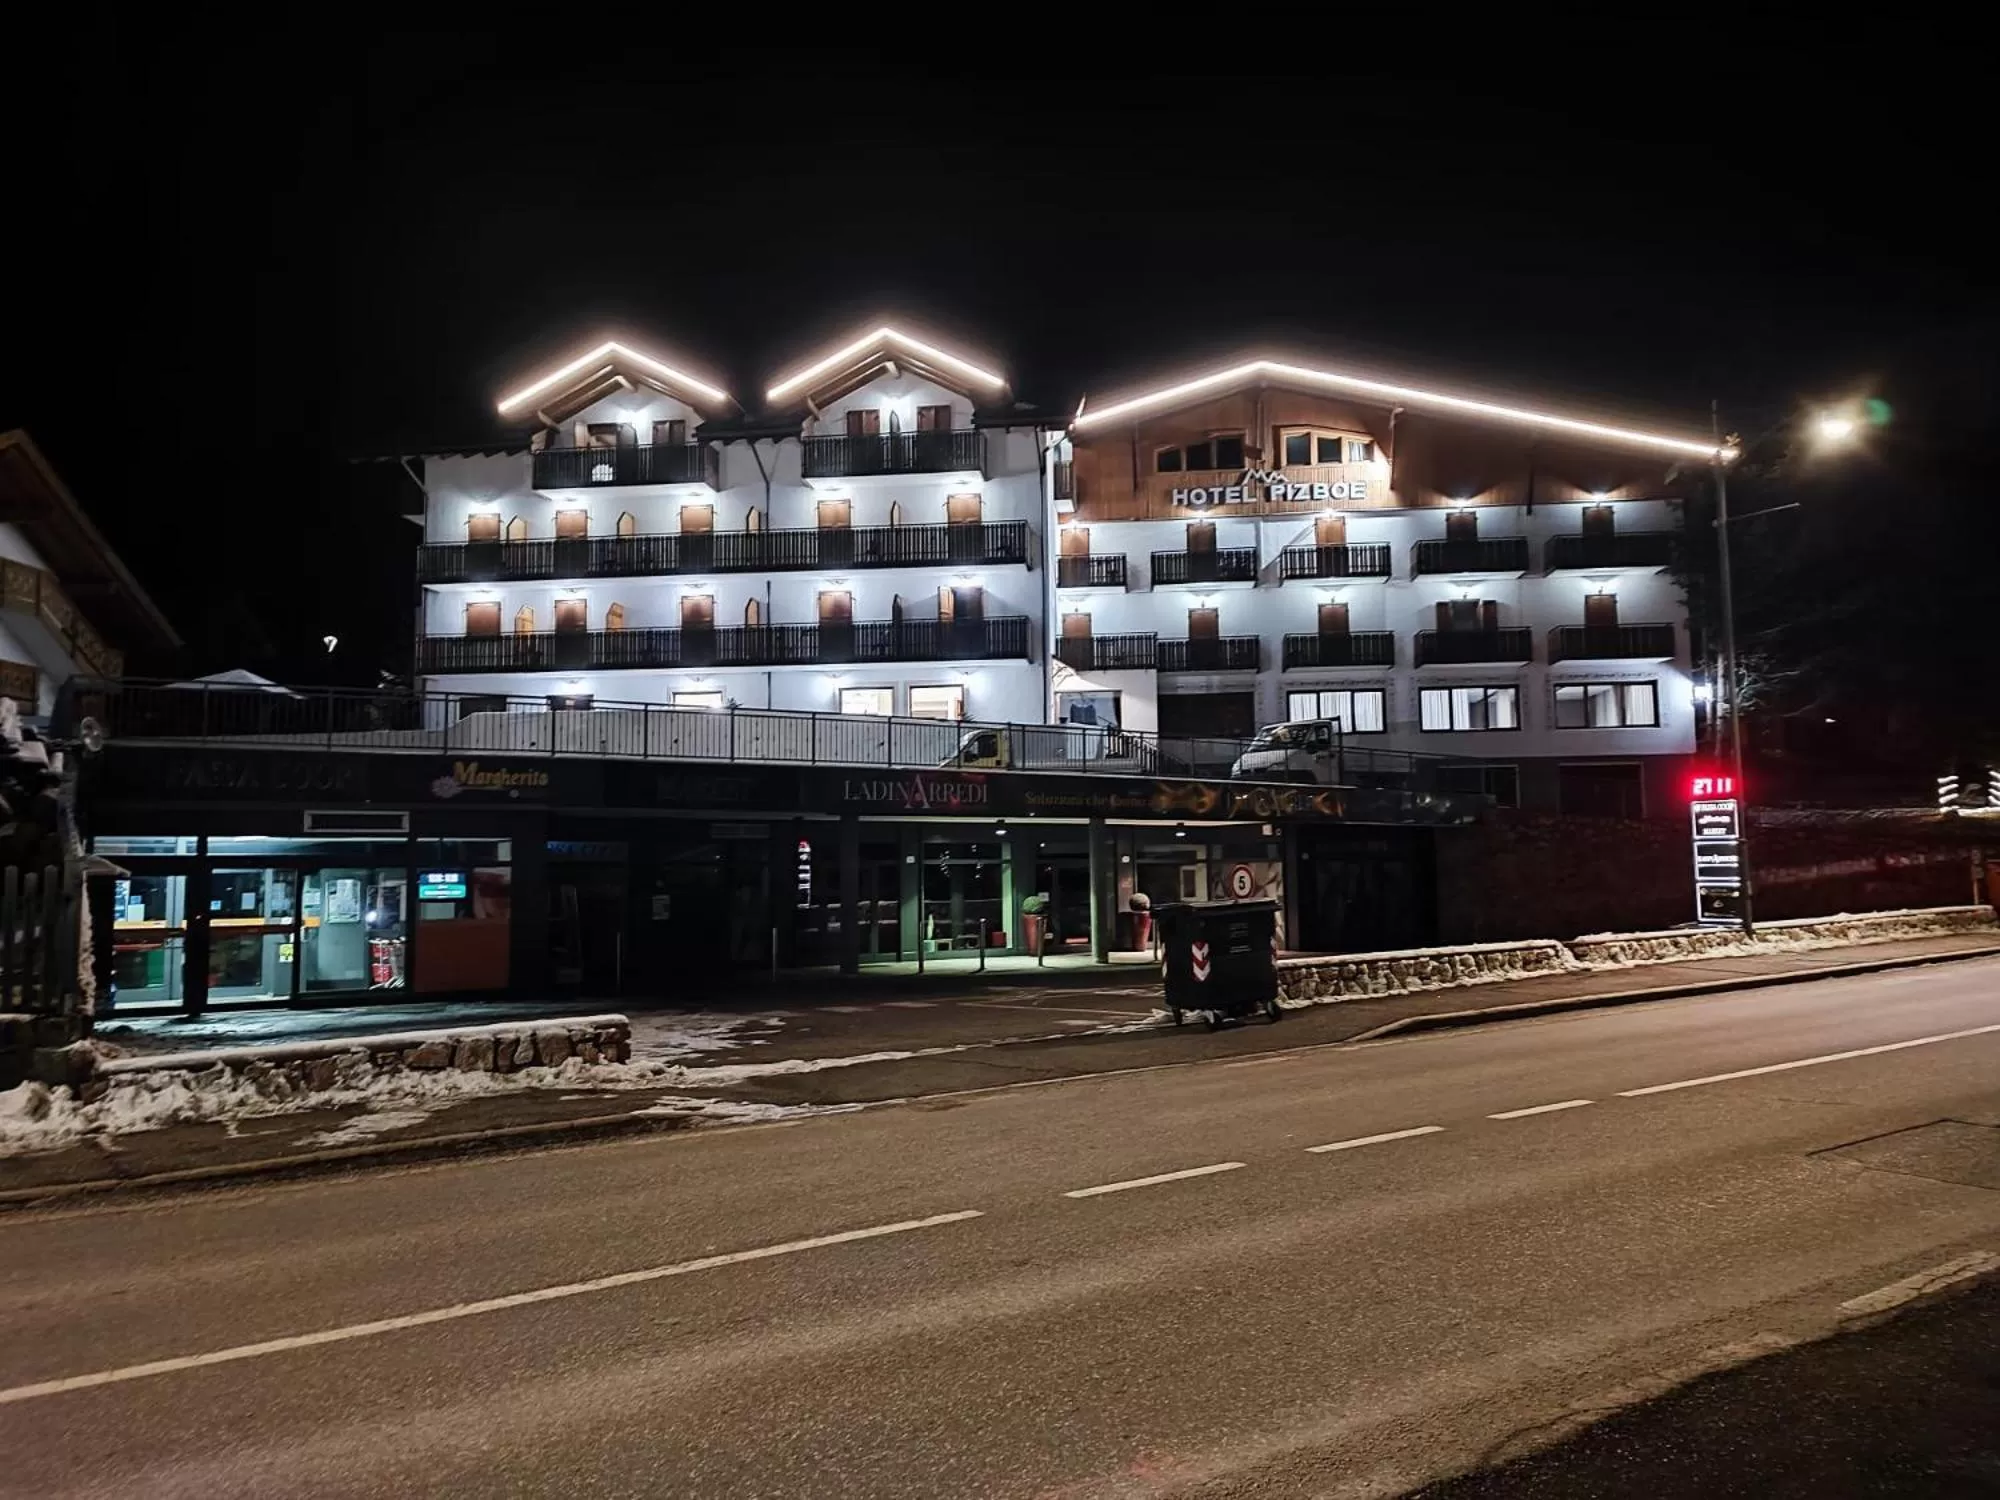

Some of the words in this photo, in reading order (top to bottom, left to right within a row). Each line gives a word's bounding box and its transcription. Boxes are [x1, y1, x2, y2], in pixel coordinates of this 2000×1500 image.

[1171, 485, 1257, 507] HOTEL
[1270, 481, 1366, 502] PIZBOE
[1238, 875, 1247, 890] 5
